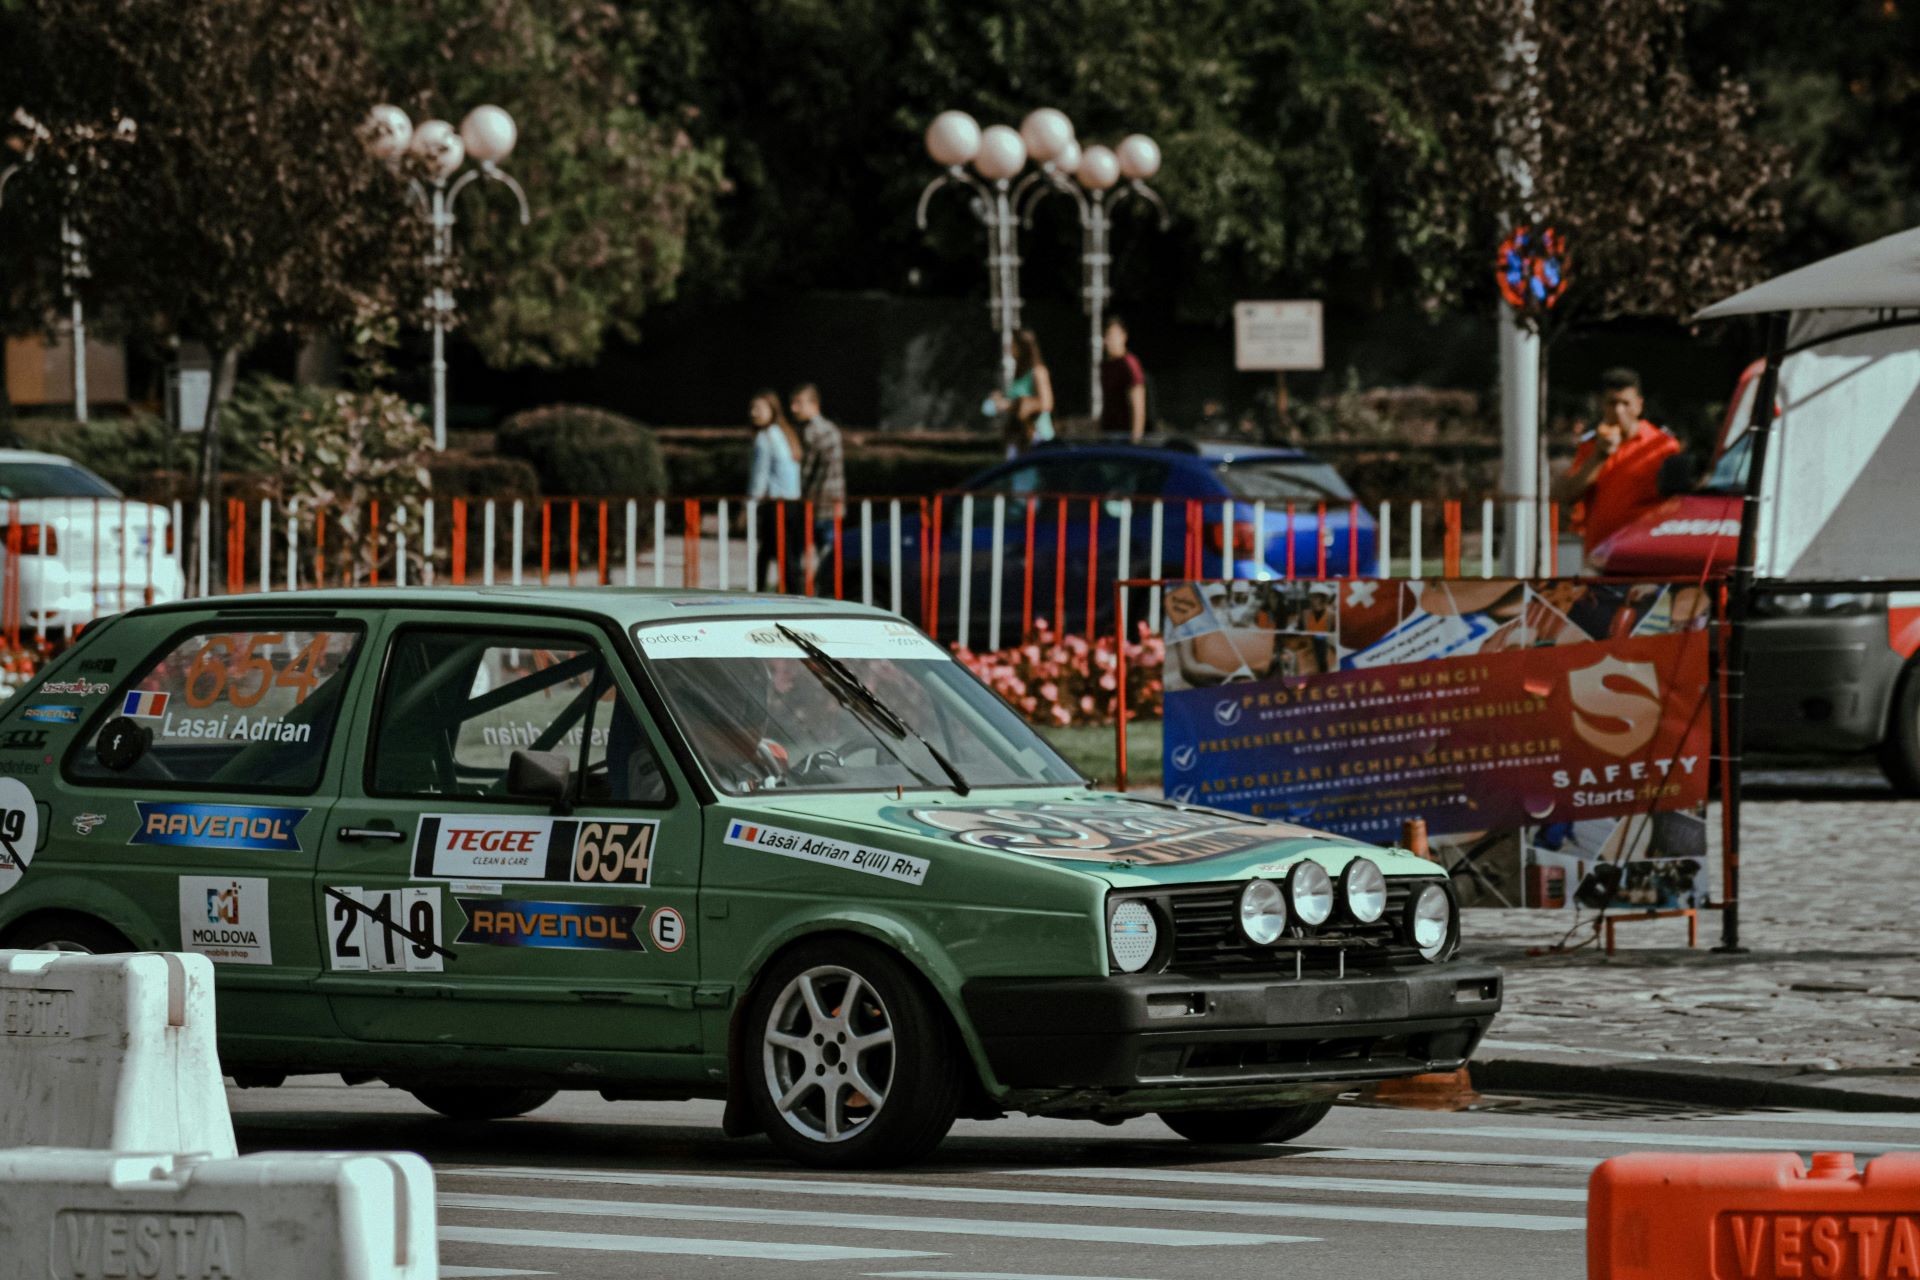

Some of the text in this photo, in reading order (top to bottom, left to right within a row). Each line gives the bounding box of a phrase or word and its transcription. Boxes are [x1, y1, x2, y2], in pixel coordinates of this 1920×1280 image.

[185, 633, 330, 708] 654
[1399, 667, 1489, 690] MUNCII
[162, 712, 311, 743] Lasai Adrian
[1552, 755, 1698, 788] SAFETY
[1573, 788, 1635, 807] Starts
[146, 812, 289, 840] RAVENOL
[447, 829, 542, 852] TEGEE
[472, 856, 529, 866] CLEAN & CARE
[575, 822, 650, 883] 654
[800, 838, 849, 862] Adrian
[891, 858, 922, 877] Rh+
[192, 929, 258, 944] MOLDOVA
[473, 910, 629, 940] RAVENOL
[659, 916, 676, 944] E
[231, 949, 249, 960] shop
[67, 1214, 232, 1280] VESTA
[1731, 1216, 1920, 1279] VESTA
